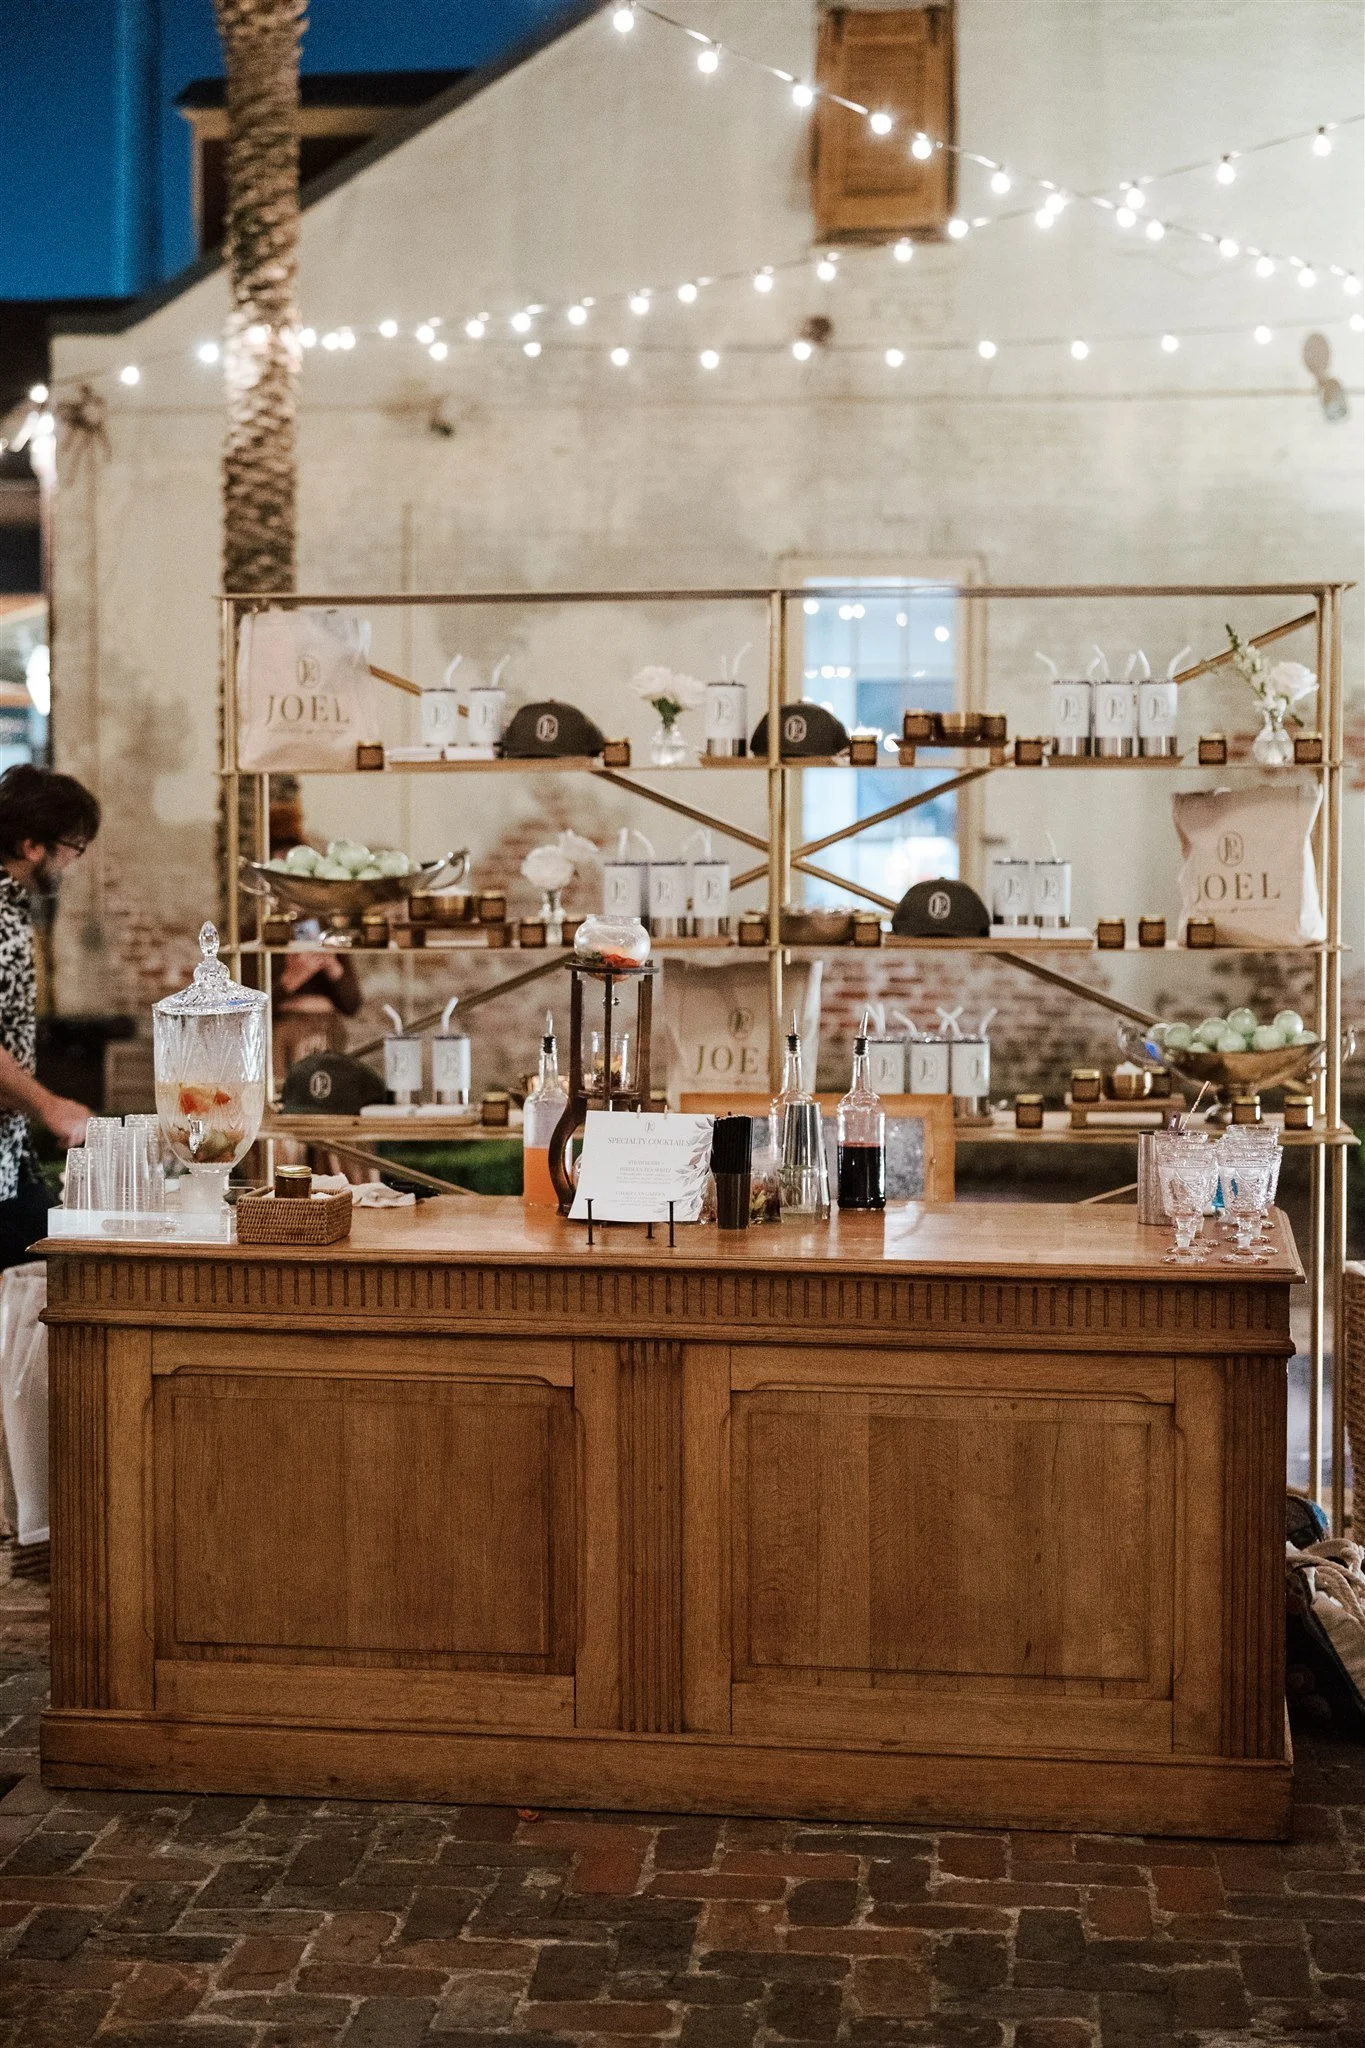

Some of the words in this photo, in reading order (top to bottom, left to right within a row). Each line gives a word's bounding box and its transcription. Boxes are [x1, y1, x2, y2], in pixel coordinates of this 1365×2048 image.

[264, 694, 350, 726] JOEL
[696, 1045, 760, 1076] JOE
[607, 1136, 646, 1145] SPECIALTY
[647, 1137, 690, 1147] COCKTAILS
